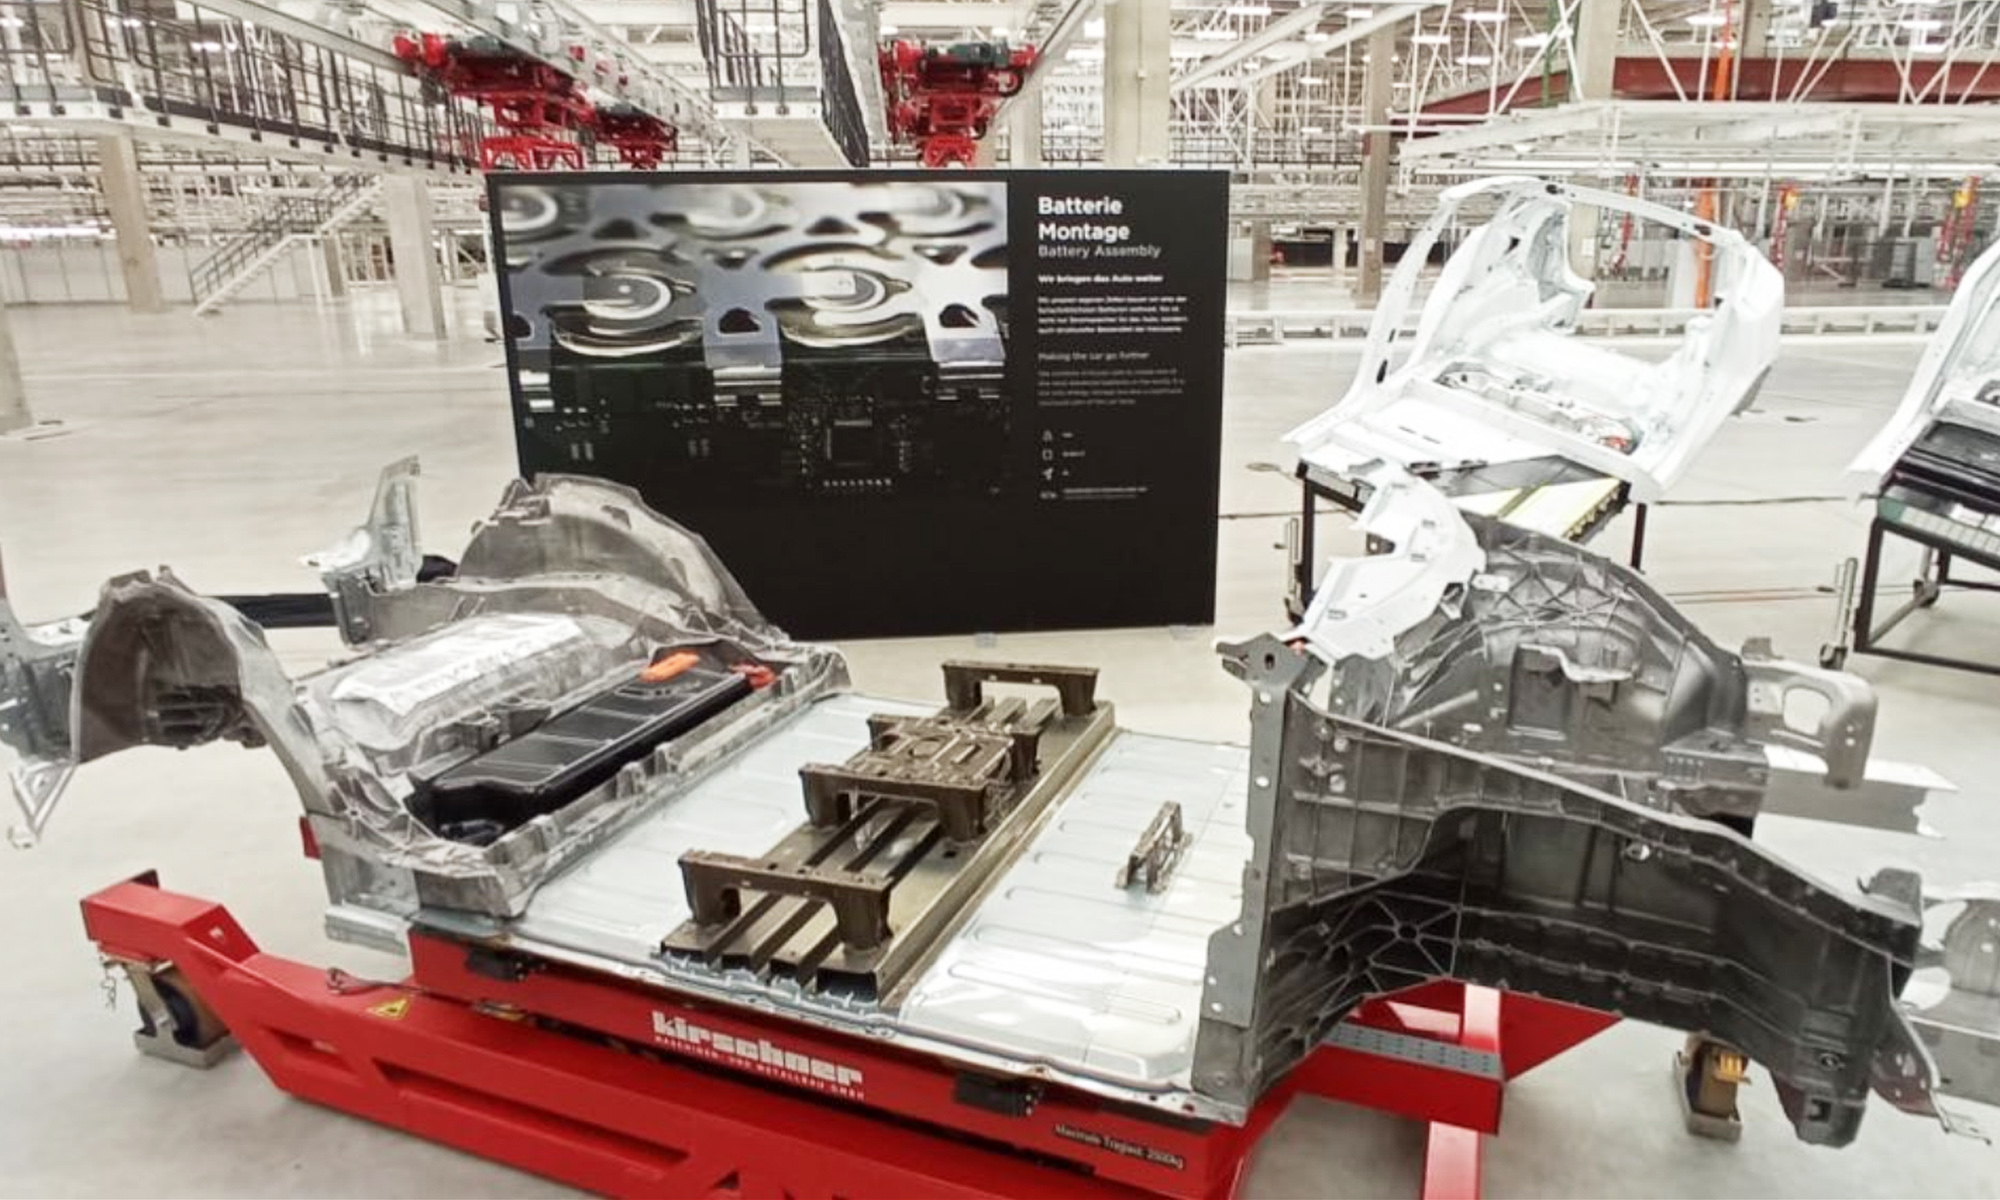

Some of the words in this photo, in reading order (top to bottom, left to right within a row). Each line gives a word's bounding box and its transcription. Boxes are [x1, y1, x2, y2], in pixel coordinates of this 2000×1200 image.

[1038, 196, 1123, 215] Batterie
[1038, 223, 1130, 243] Montage
[1038, 245, 1090, 259] Battery
[1095, 245, 1161, 259] Assembly
